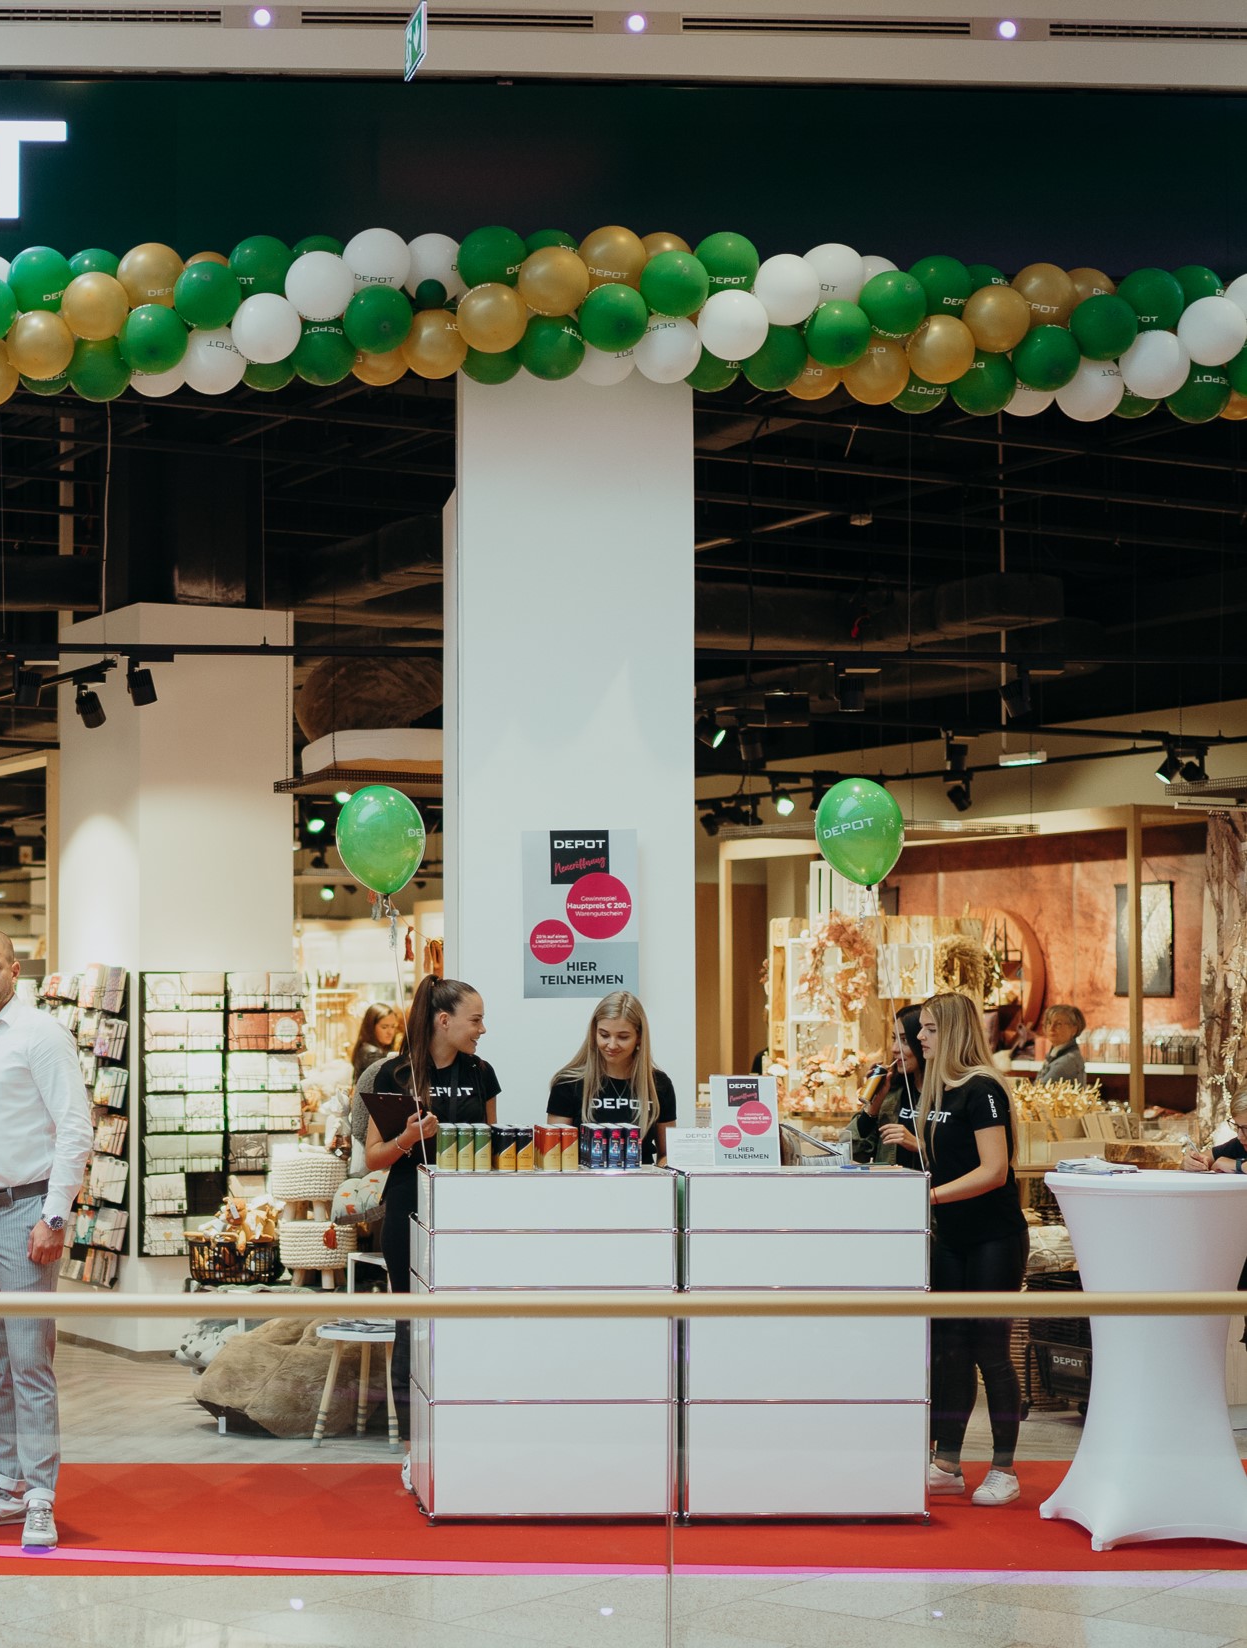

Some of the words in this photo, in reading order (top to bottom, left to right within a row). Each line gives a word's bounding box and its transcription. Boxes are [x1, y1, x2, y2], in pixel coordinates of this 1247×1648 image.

[588, 267, 628, 279] DEPOT
[354, 274, 394, 284] DEPOT
[43, 289, 65, 301] DEP
[148, 288, 173, 296] DEP
[943, 297, 967, 306] DEP
[1031, 301, 1058, 313] POT
[304, 326, 343, 335] DEPOT
[644, 322, 676, 333] DEPO
[207, 341, 239, 353] EPOT
[615, 349, 634, 358] POT
[1102, 369, 1122, 377] POT
[823, 818, 874, 839] DEPOT
[554, 840, 606, 849] DEPOT
[566, 962, 597, 971] HIER
[540, 975, 624, 985] TEILNEHMEN
[988, 1094, 997, 1118] DEPOT
[1052, 1355, 1083, 1367] DEPOT
